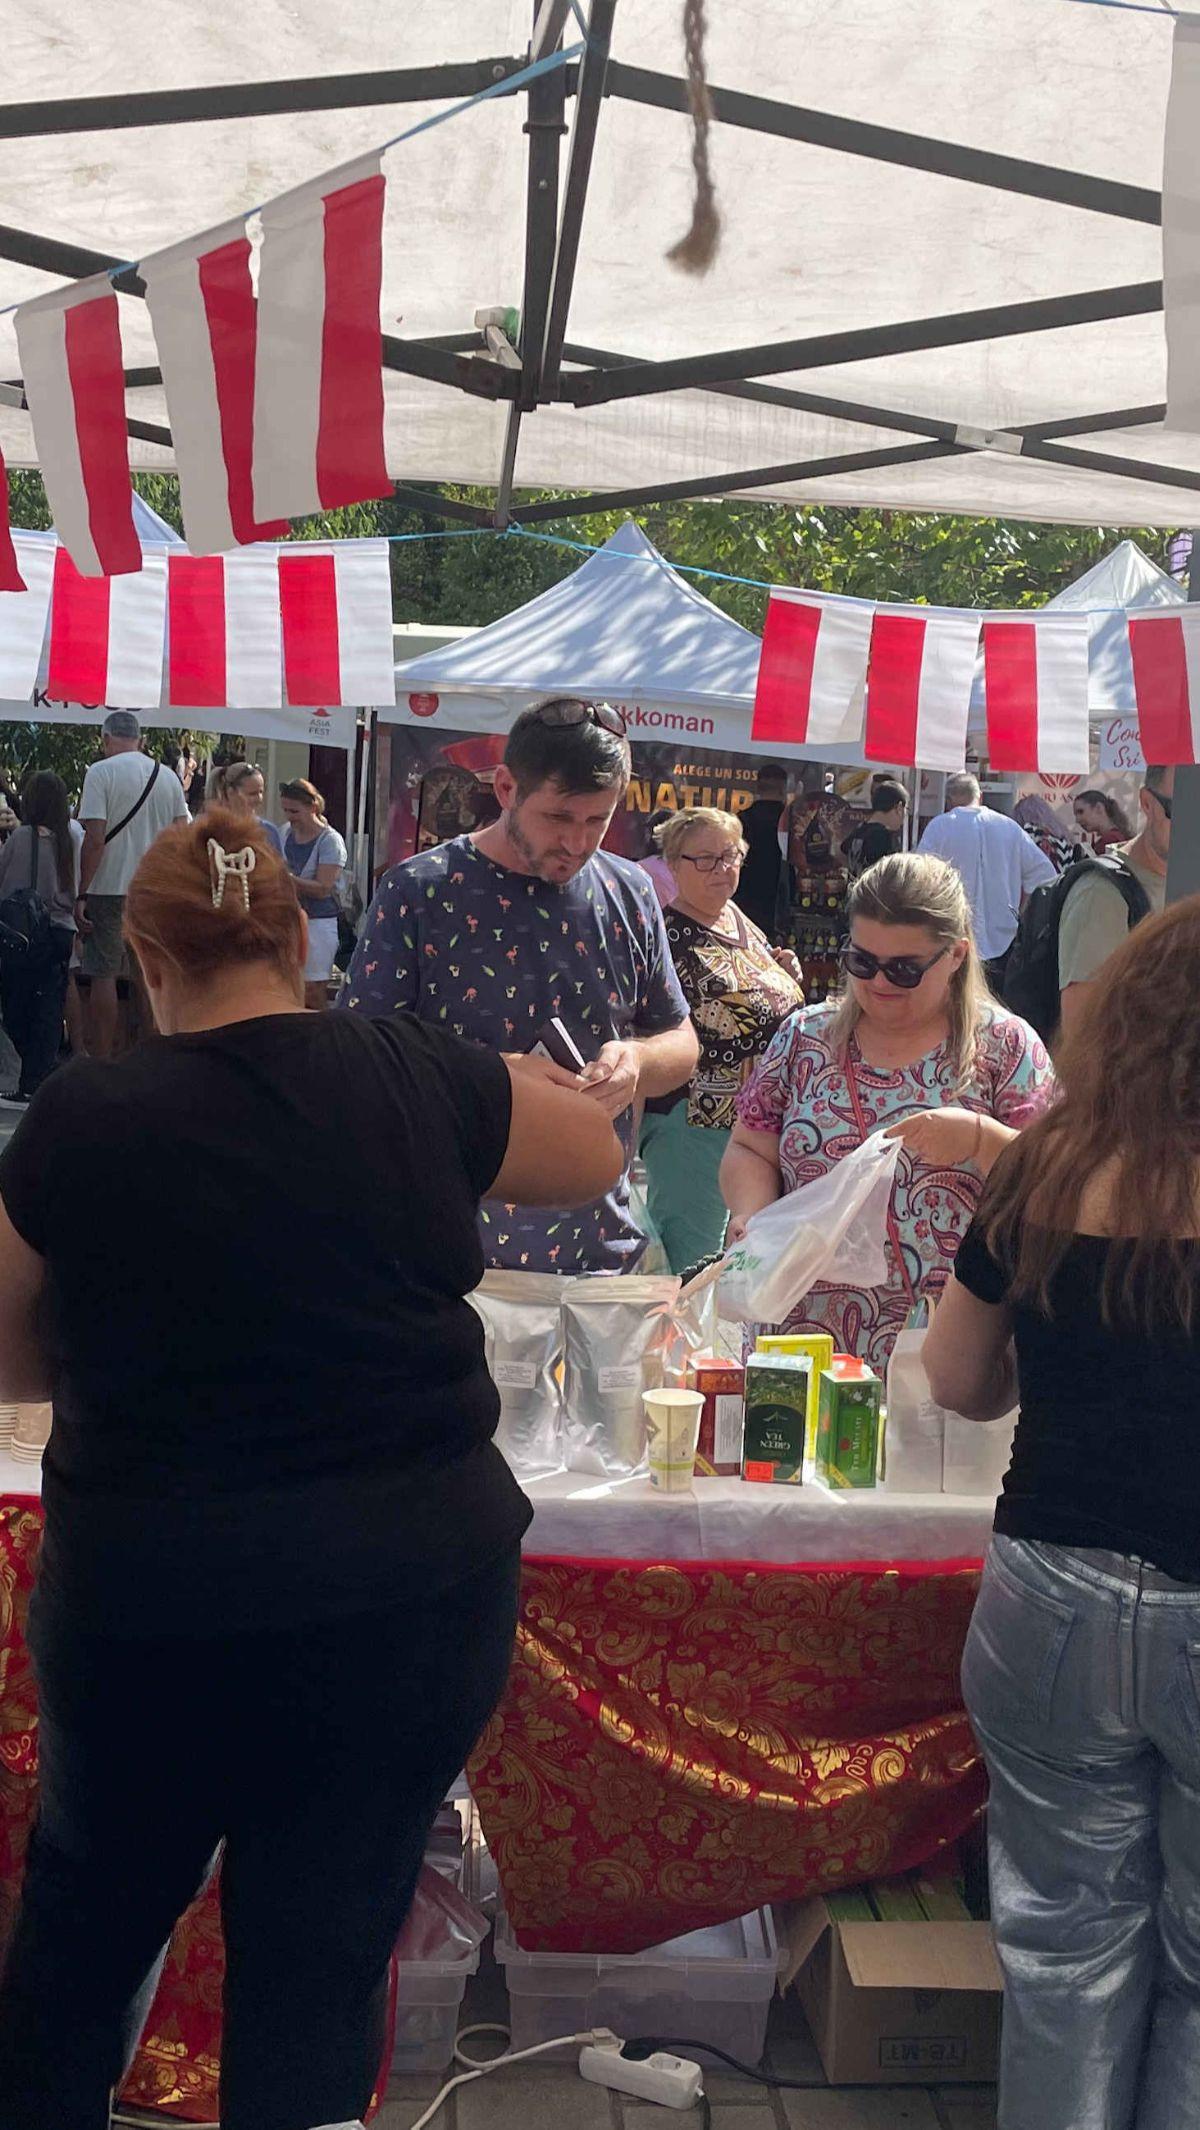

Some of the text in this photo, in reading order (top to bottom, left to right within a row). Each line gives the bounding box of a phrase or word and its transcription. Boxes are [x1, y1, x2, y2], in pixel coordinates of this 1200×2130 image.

[310, 719, 330, 727] ASIA
[621, 706, 714, 734] kkoman
[308, 727, 330, 735] FEST
[1113, 745, 1140, 768] Sri
[673, 764, 758, 781] ALEGE UN SOS
[626, 780, 754, 813] NATUR
[765, 1431, 783, 1441] TEA
[760, 1439, 791, 1450] GREEN
